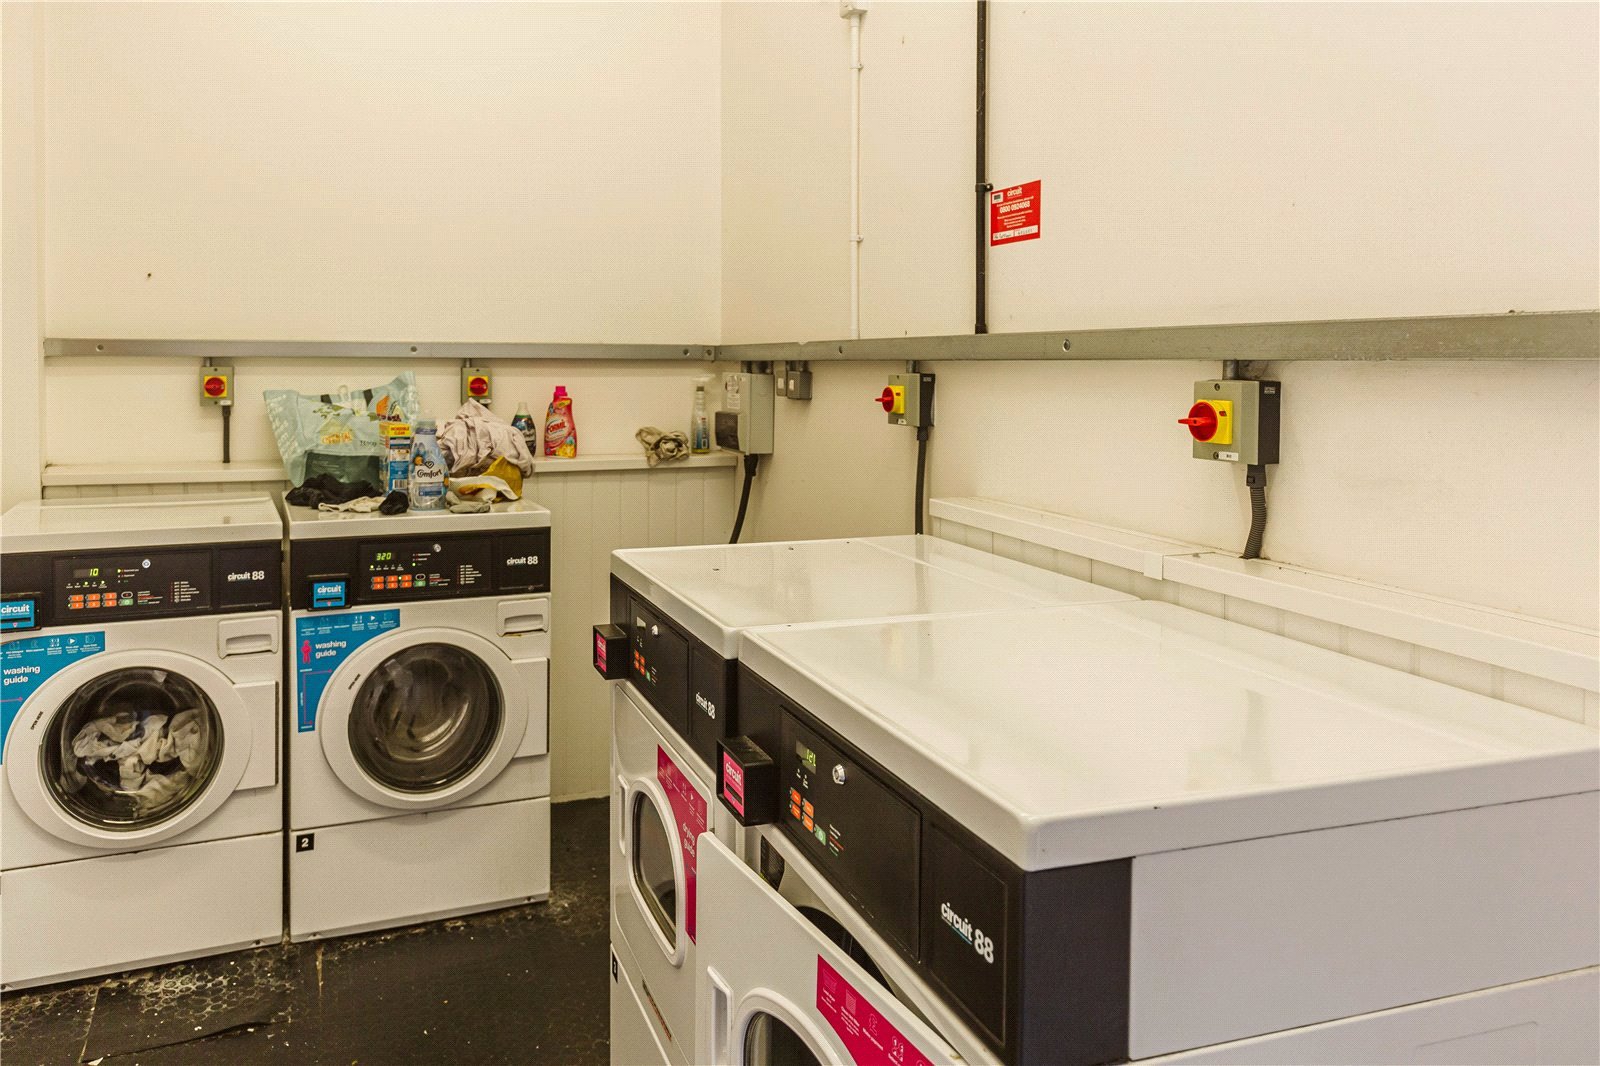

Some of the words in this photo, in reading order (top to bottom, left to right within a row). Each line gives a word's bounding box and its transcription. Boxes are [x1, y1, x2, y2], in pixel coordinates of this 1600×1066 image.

[416, 469, 442, 479] Comfort
[376, 552, 392, 560] 320
[506, 556, 526, 566] circuit
[527, 555, 538, 565] 88
[89, 568, 99, 577] 10
[227, 571, 251, 581] circuit
[252, 570, 265, 580] 88
[317, 584, 342, 594] circuit
[0, 604, 30, 614] circuit
[315, 639, 347, 650] washing
[315, 649, 337, 659] guide
[3, 665, 41, 676] washing
[3, 675, 29, 686] guide
[707, 701, 716, 719] 88
[725, 761, 742, 787] circuit
[301, 837, 309, 848] 2
[941, 902, 973, 942] circuit
[974, 928, 995, 964] 88
